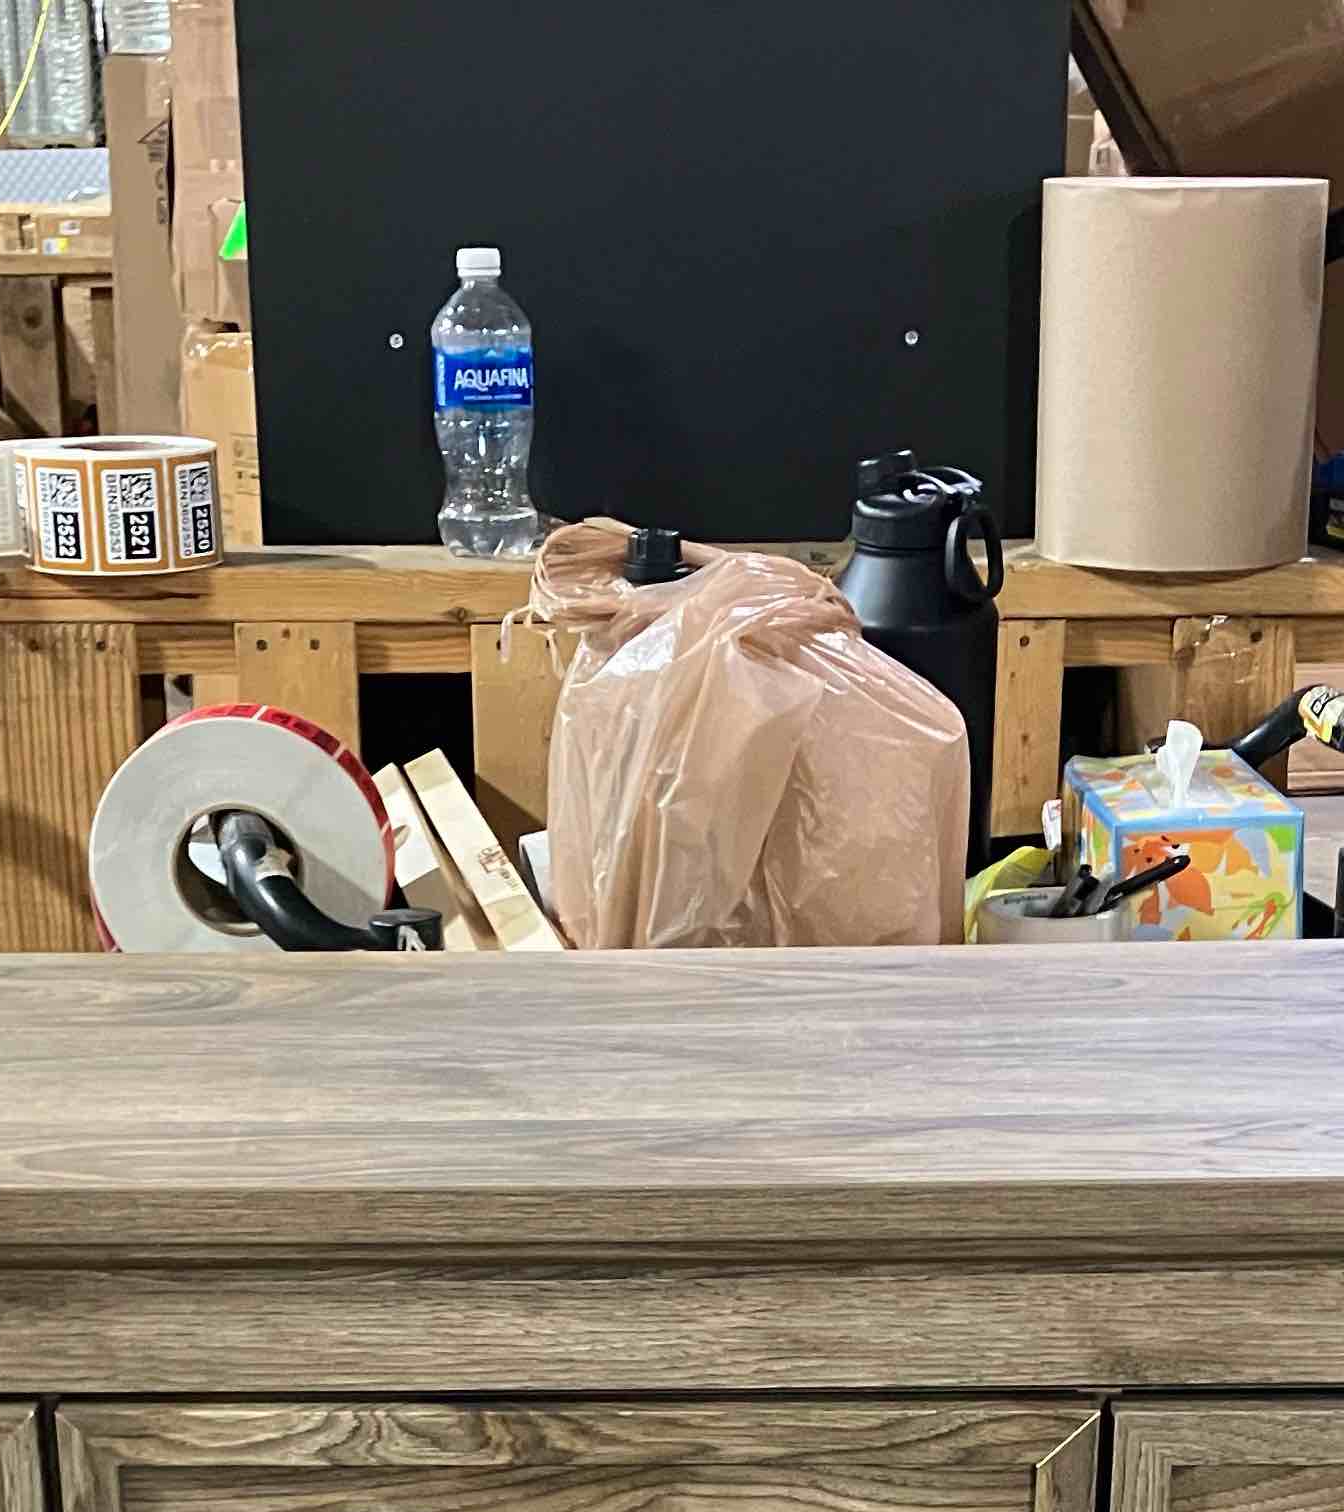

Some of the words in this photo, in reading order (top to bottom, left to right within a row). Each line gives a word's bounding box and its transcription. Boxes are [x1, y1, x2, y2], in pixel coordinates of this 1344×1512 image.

[453, 367, 529, 392] AQUAFINA
[56, 512, 77, 558] 2522
[104, 473, 121, 560] BRN3602521
[129, 513, 150, 557] 2521
[193, 506, 211, 551] 2520
